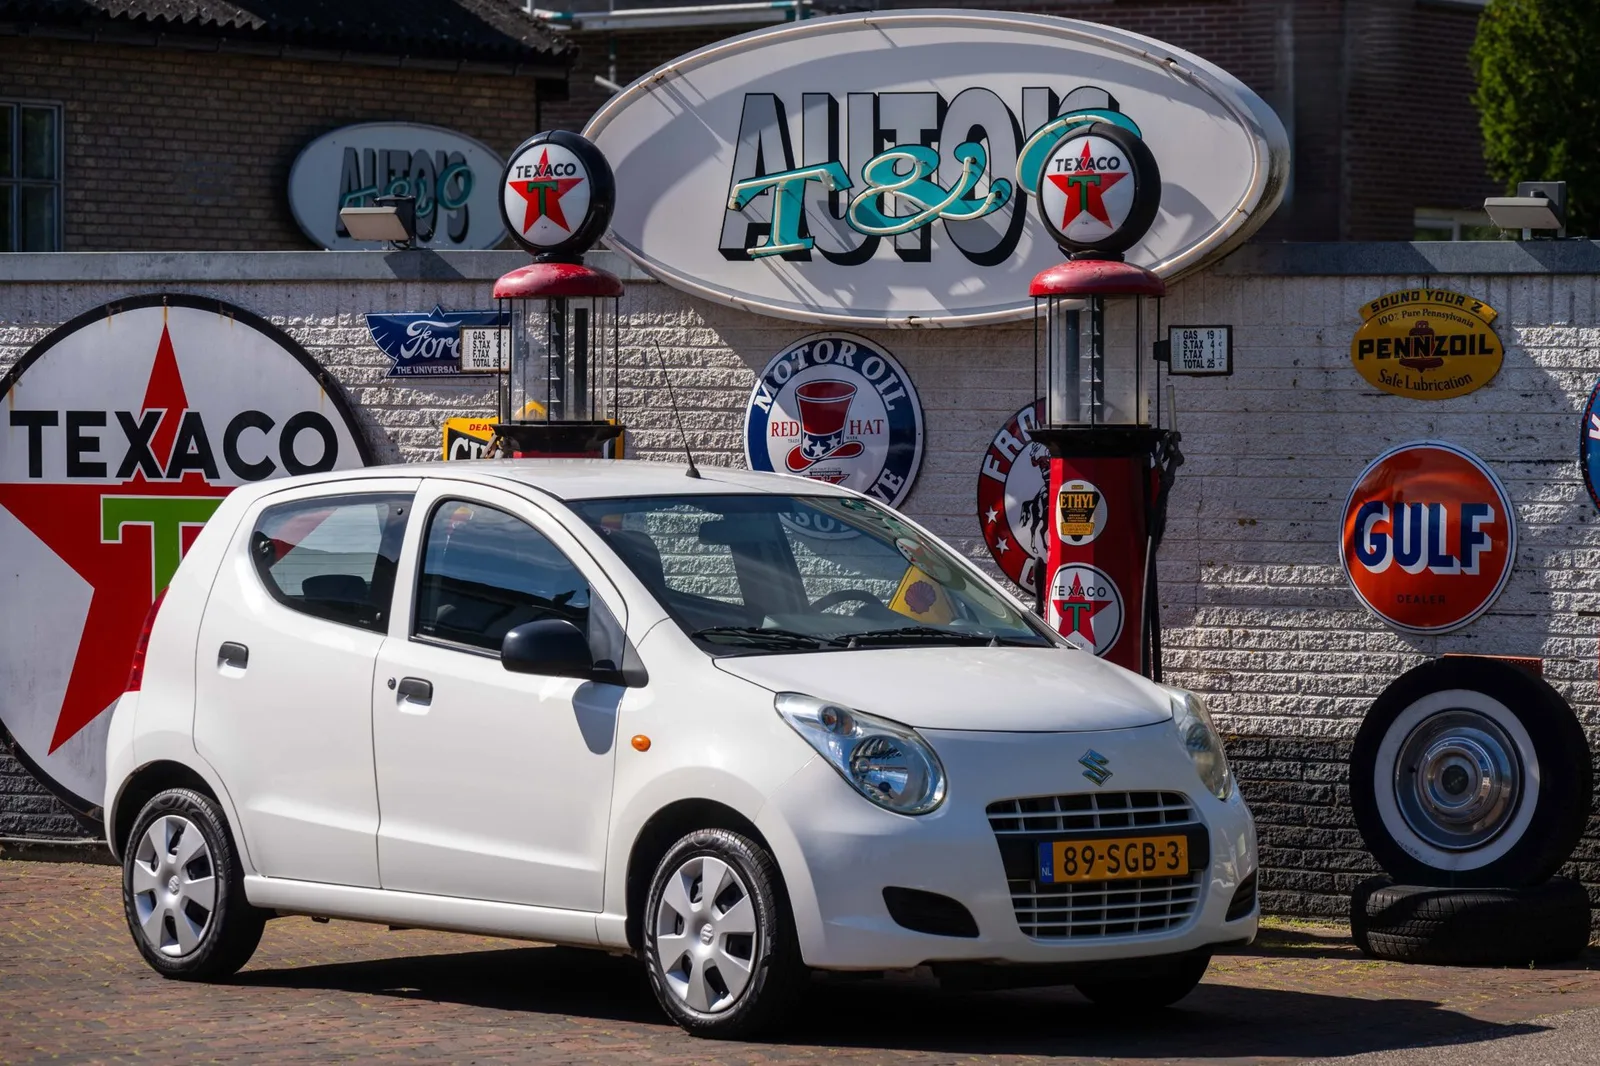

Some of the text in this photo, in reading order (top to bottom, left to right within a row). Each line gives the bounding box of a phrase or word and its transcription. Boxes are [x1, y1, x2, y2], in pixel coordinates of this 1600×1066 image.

[516, 163, 577, 178] TEXACO
[1055, 156, 1121, 172] TEXACO
[527, 180, 559, 216] T
[1068, 175, 1101, 211] T
[1370, 290, 1484, 314] SOUND YOUR Z
[1402, 310, 1421, 319] Pure
[1422, 308, 1474, 329] Pennsylvania
[472, 331, 486, 340] GAS
[1183, 330, 1215, 340] GAS 19
[472, 340, 490, 349] S.TAX
[1183, 340, 1215, 349] S.TAX 4
[1358, 334, 1495, 360] PENNZOIL
[472, 350, 490, 358] F.TAX
[1183, 350, 1203, 359] F.TAX
[396, 366, 460, 374] THE UNIVERSAL
[472, 359, 490, 368] TOTAL
[1183, 359, 1215, 369] TOTAL 25
[754, 340, 906, 415] MOTOR OIL
[1378, 368, 1473, 391] Safe Lubrication
[771, 419, 884, 437] RED HAT
[9, 410, 339, 481] TEXACO
[1060, 493, 1096, 509] ETHYL
[1354, 501, 1495, 575] GULF
[1055, 585, 1107, 598] TEXACO
[1397, 594, 1446, 604] DEALER
[1063, 602, 1091, 632] T
[1041, 841, 1180, 877] NL 89-SGB-3
